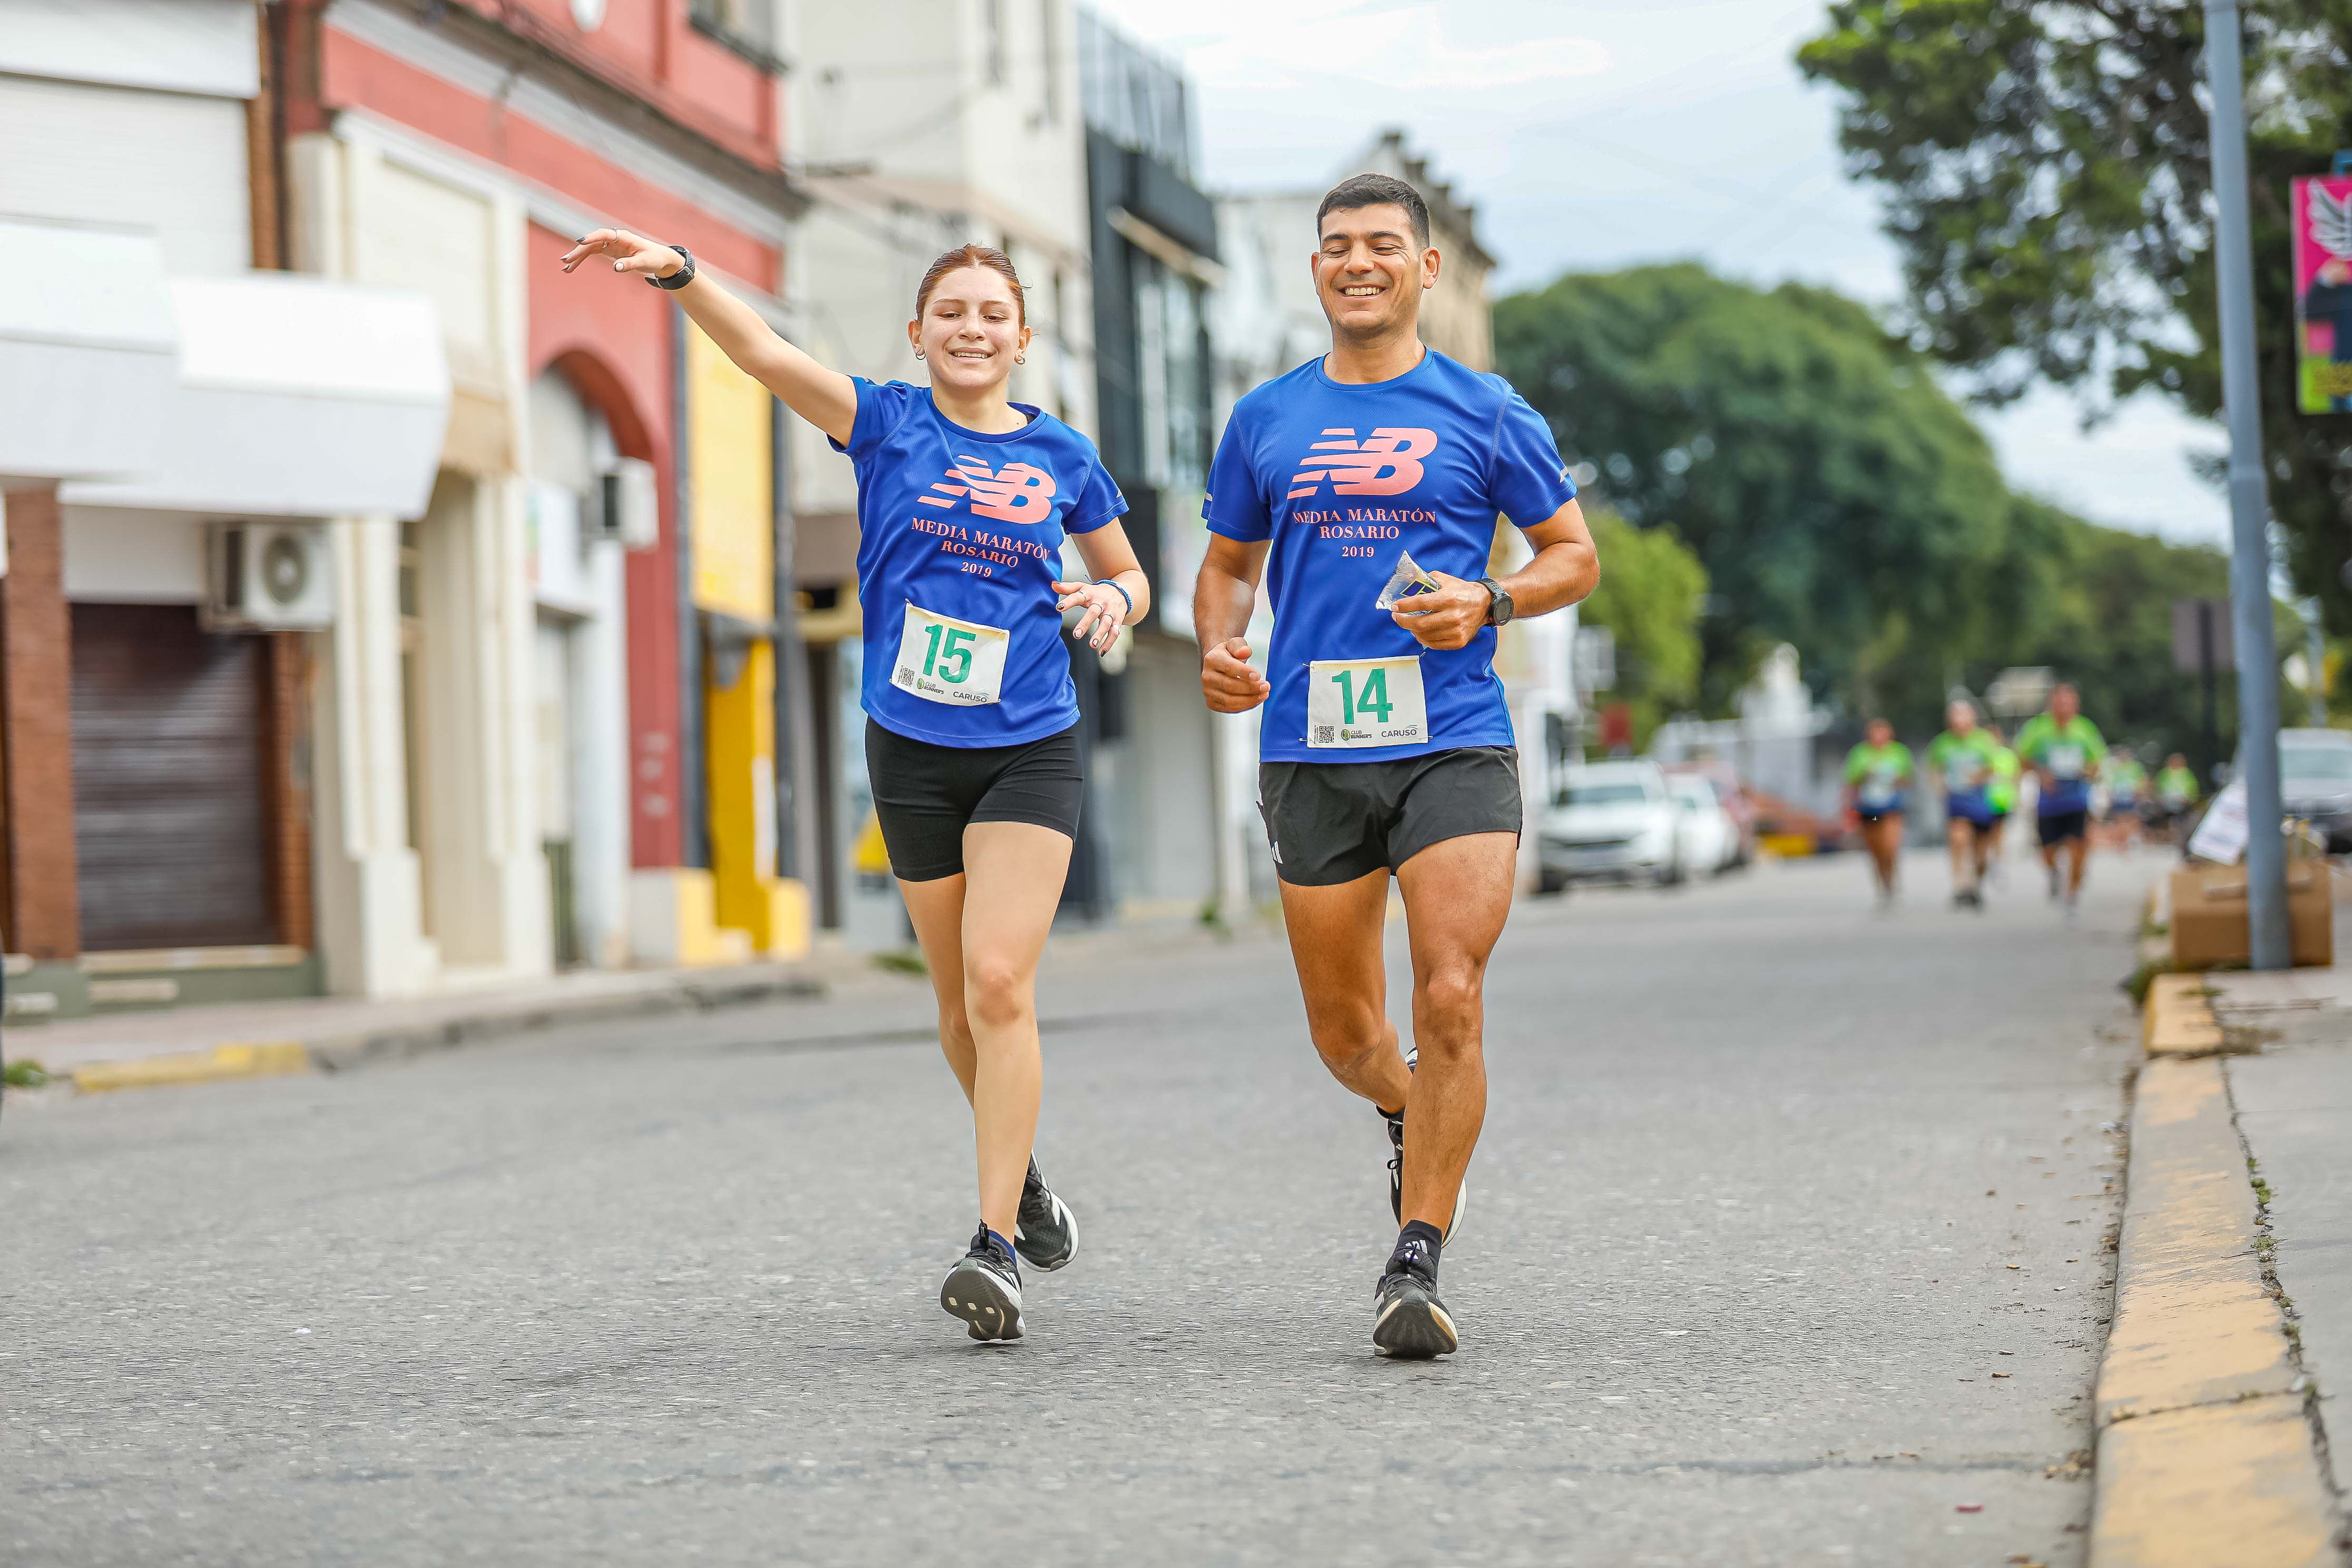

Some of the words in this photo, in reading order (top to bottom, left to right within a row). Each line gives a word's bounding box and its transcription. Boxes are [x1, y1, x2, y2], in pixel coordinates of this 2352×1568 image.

[1292, 509, 1342, 524] MEDIA
[1347, 508, 1436, 523] MARATÓN
[911, 517, 968, 541] MEDIA
[973, 530, 1051, 562] MARATÓN
[1319, 525, 1400, 540] ROSARIO
[941, 540, 1018, 568] ROSARIO
[1341, 546, 1375, 558] 2019
[961, 562, 993, 578] 2019
[923, 624, 977, 684] 15
[953, 691, 987, 703] CARUSO
[1331, 668, 1393, 724] 14
[1381, 729, 1417, 737] CARUSO
